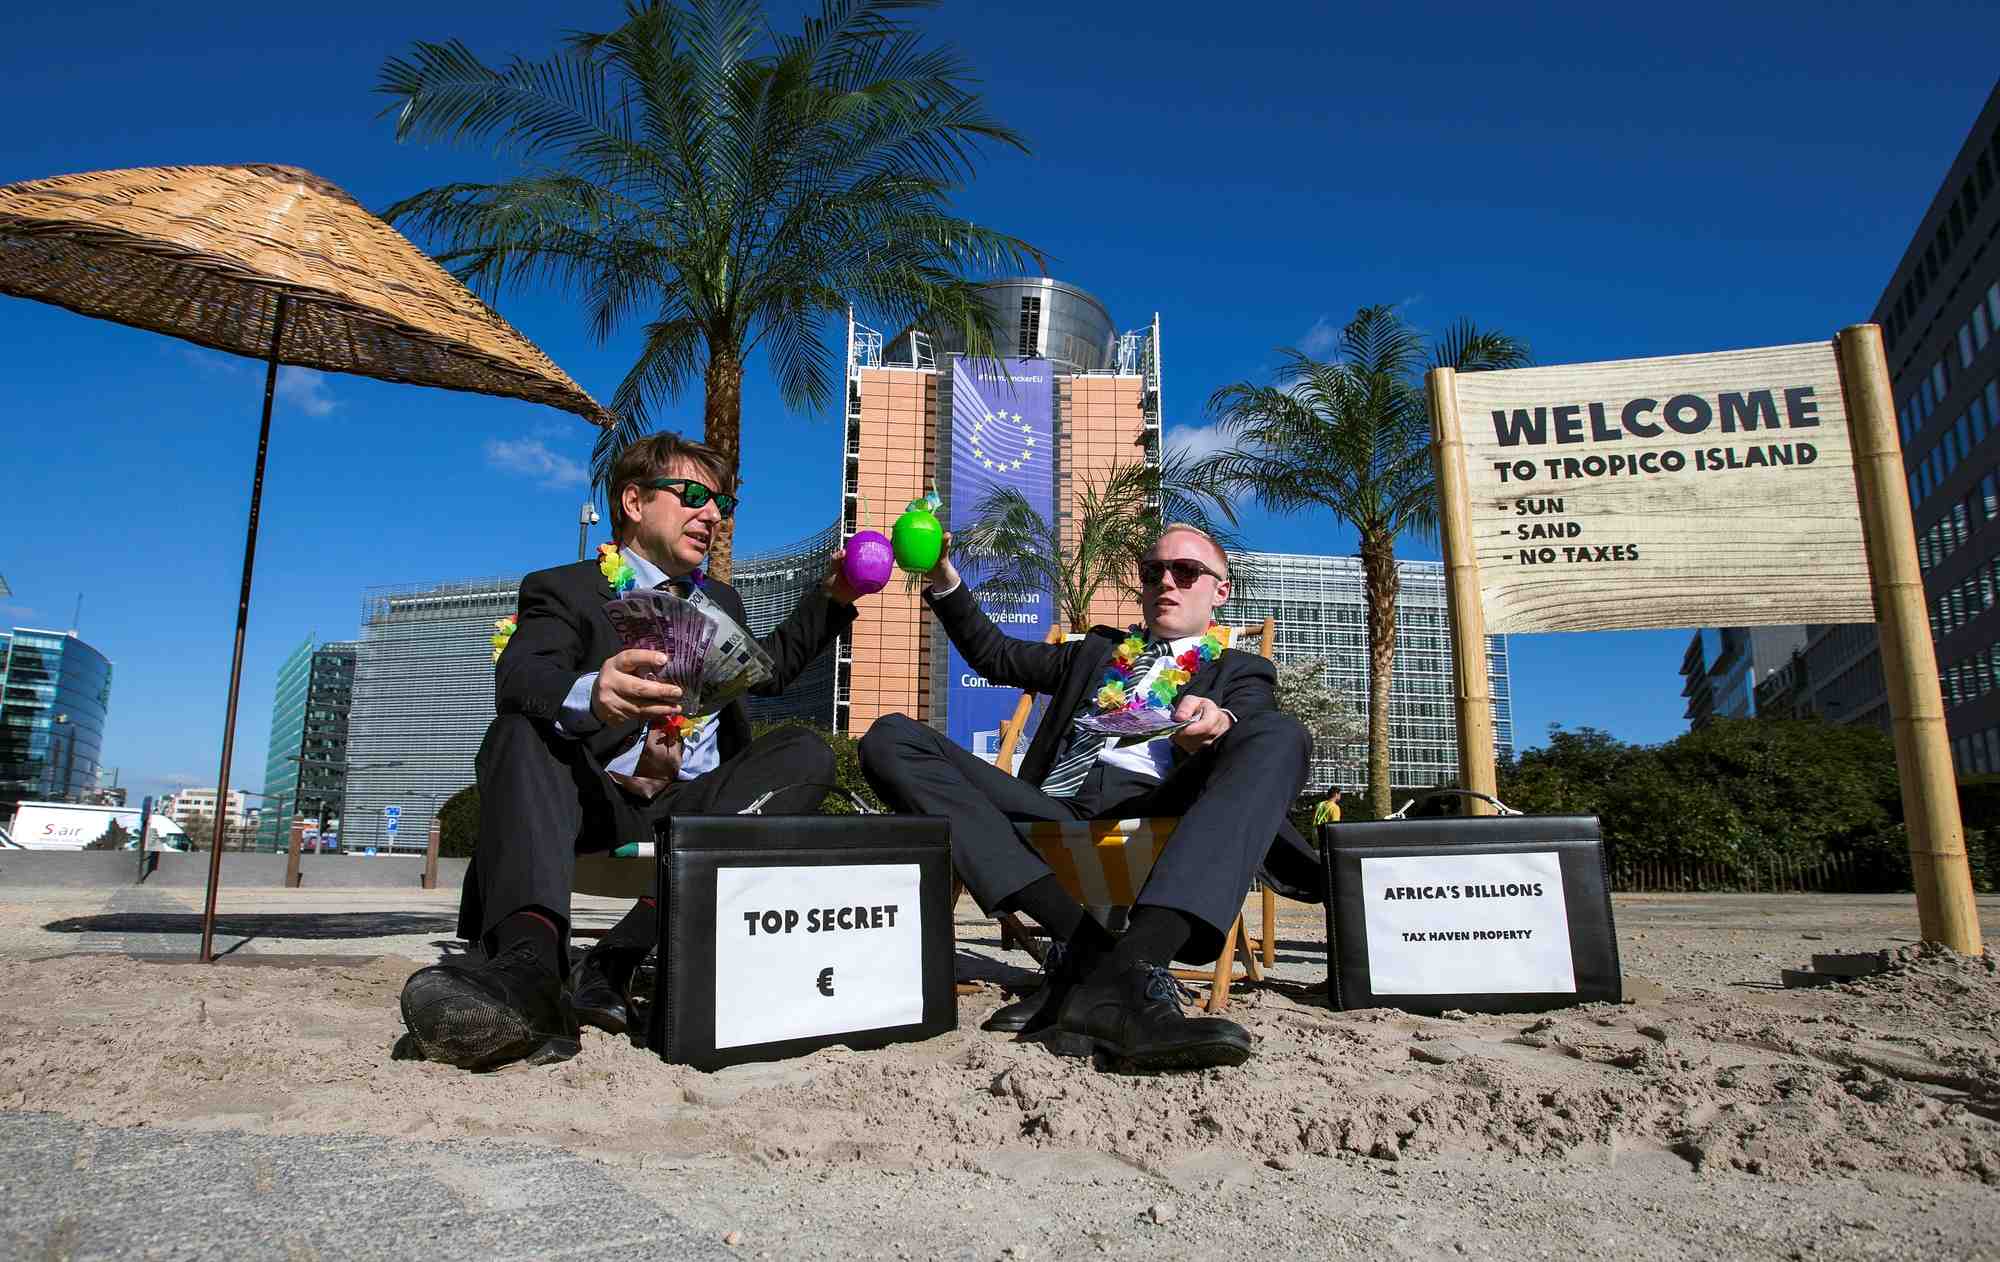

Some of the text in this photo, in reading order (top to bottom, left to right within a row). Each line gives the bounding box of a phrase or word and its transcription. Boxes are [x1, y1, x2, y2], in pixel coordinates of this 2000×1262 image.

[1490, 386, 1821, 447] WELCOME
[1494, 442, 1818, 483] TO TROPICO ISLAND
[1515, 498, 1565, 516] SUN
[1517, 521, 1582, 540] SAND
[1520, 547, 1557, 565] NO
[1562, 543, 1640, 563] TAXES
[1383, 882, 1544, 901] AFRICA'S BILLIONS
[743, 904, 899, 937] TOP SECRET
[1402, 929, 1533, 943] TAX HAVEN PROPERTY
[816, 967, 835, 997] €
